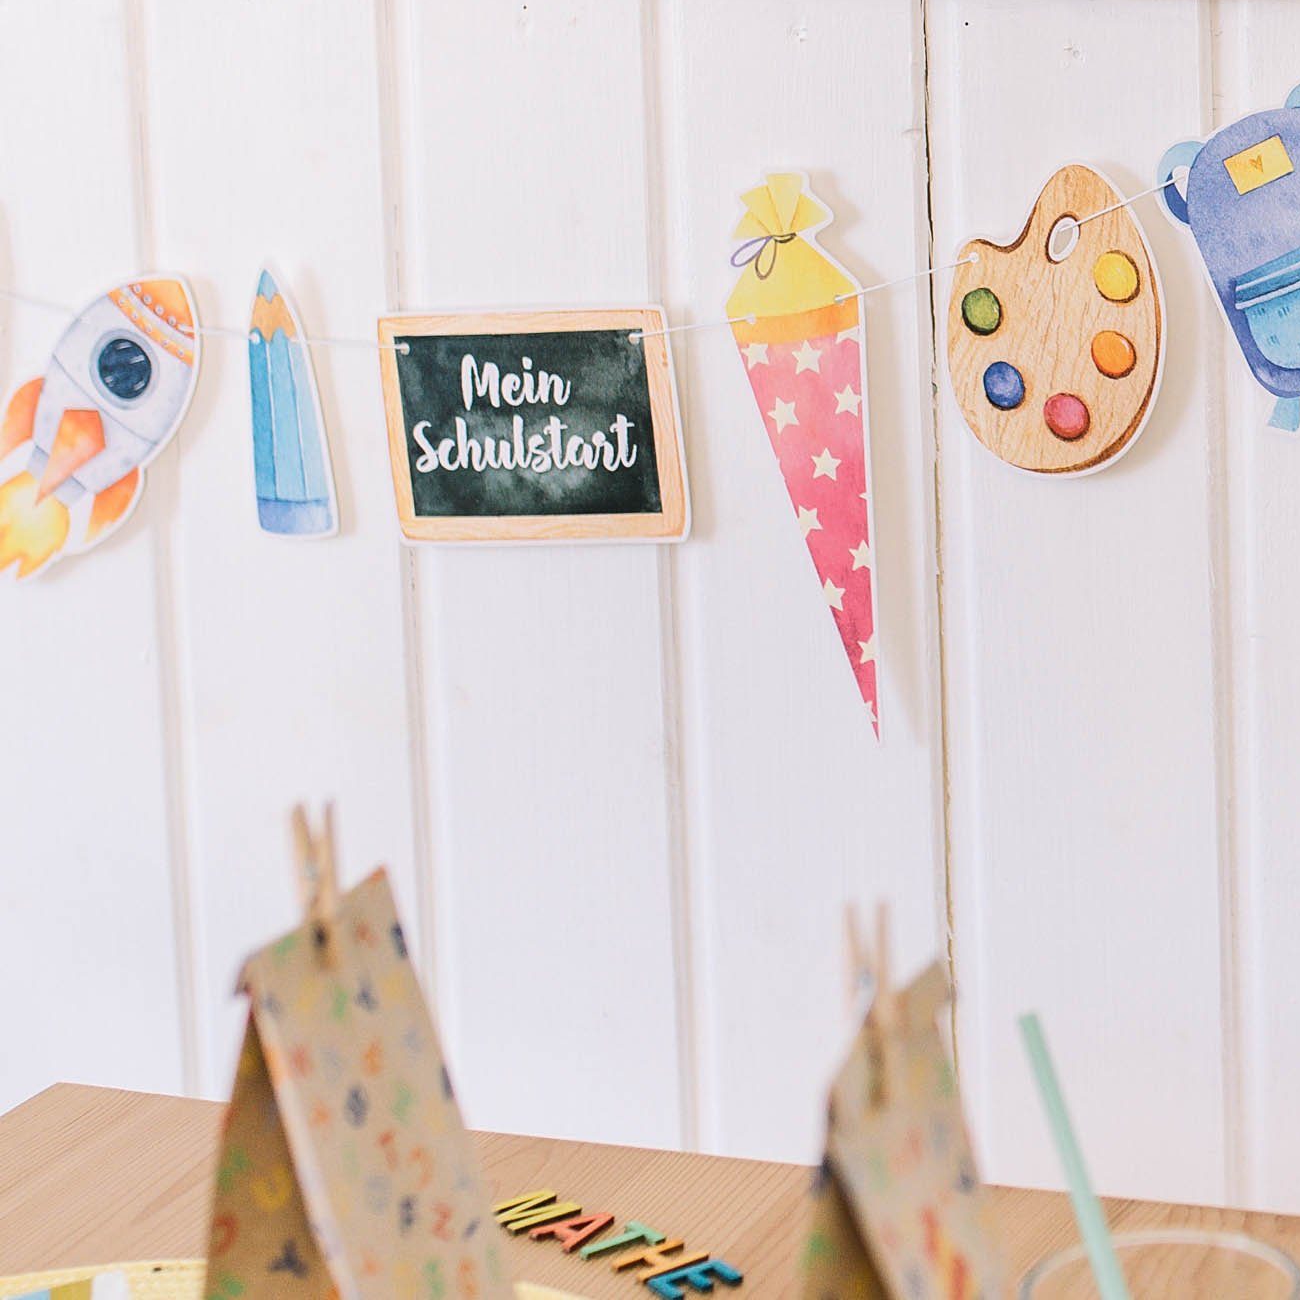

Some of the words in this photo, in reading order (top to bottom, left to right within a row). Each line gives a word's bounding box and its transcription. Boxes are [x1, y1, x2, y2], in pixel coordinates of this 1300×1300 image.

[461, 353, 571, 411] Mein
[412, 413, 638, 473] Schulstart
[491, 1189, 744, 1300] MATHE
